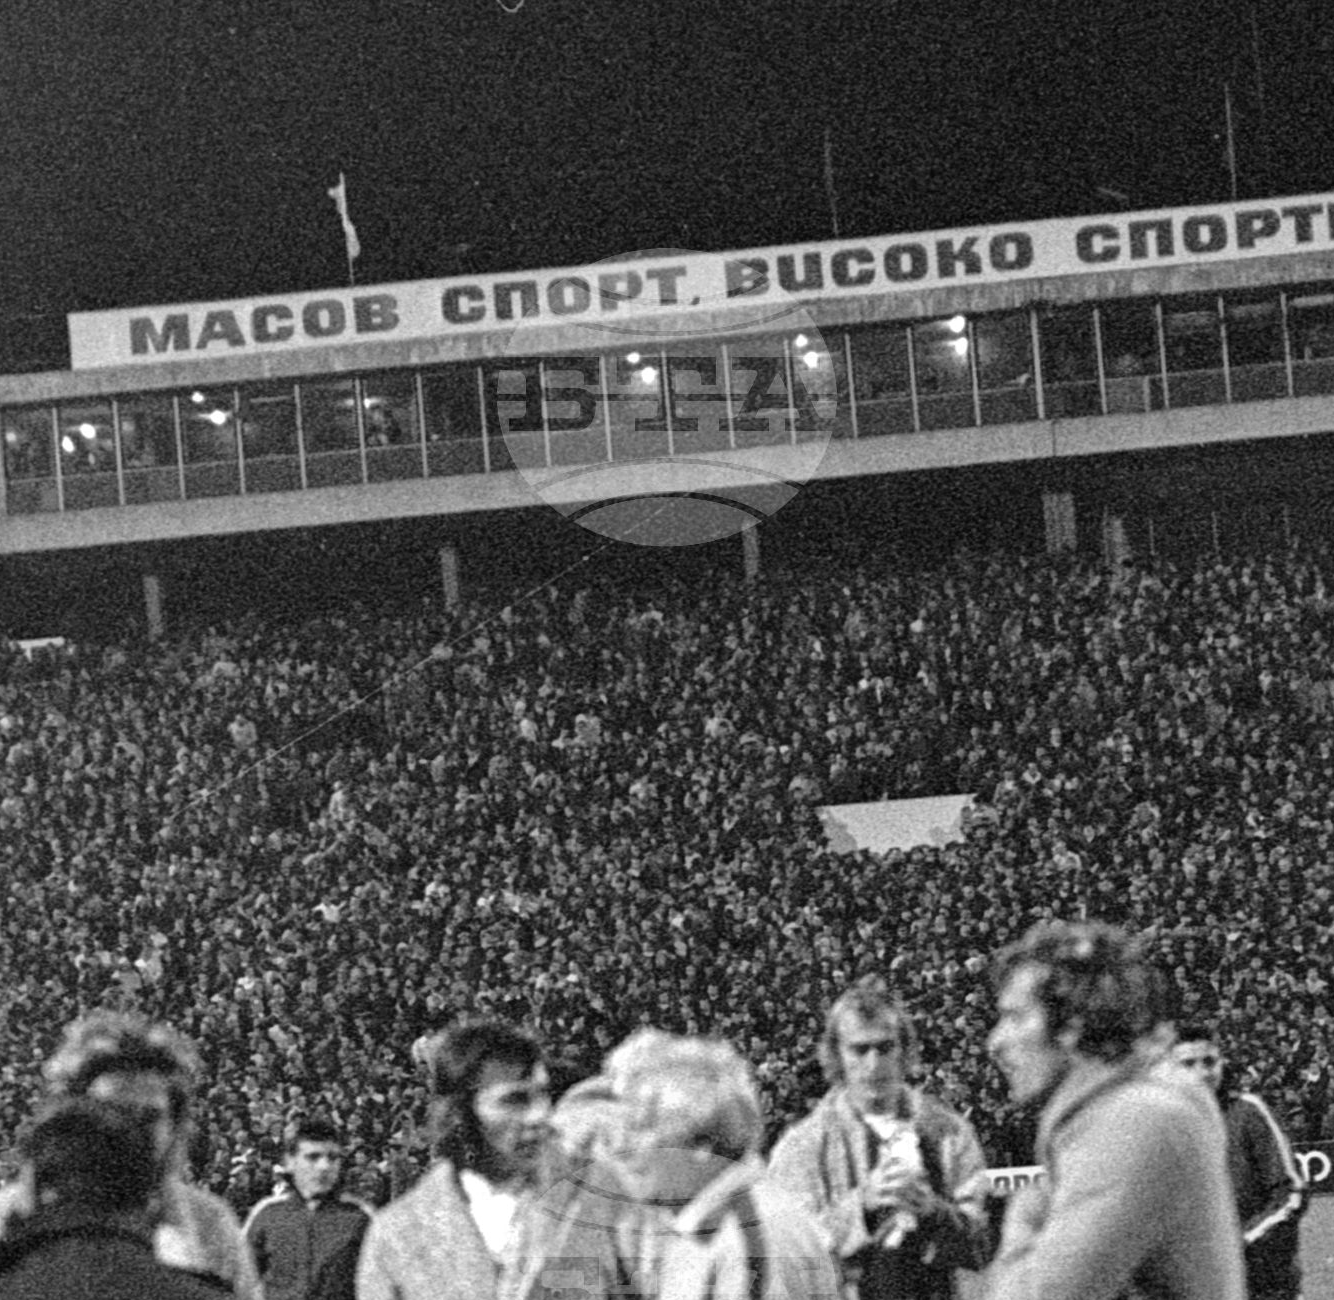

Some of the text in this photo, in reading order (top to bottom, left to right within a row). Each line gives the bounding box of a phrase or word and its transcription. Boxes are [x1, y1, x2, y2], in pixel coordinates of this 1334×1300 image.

[130, 294, 399, 355] МАСОВ
[441, 265, 700, 324] СПОРТ,
[724, 231, 1035, 298] ВИСОКО
